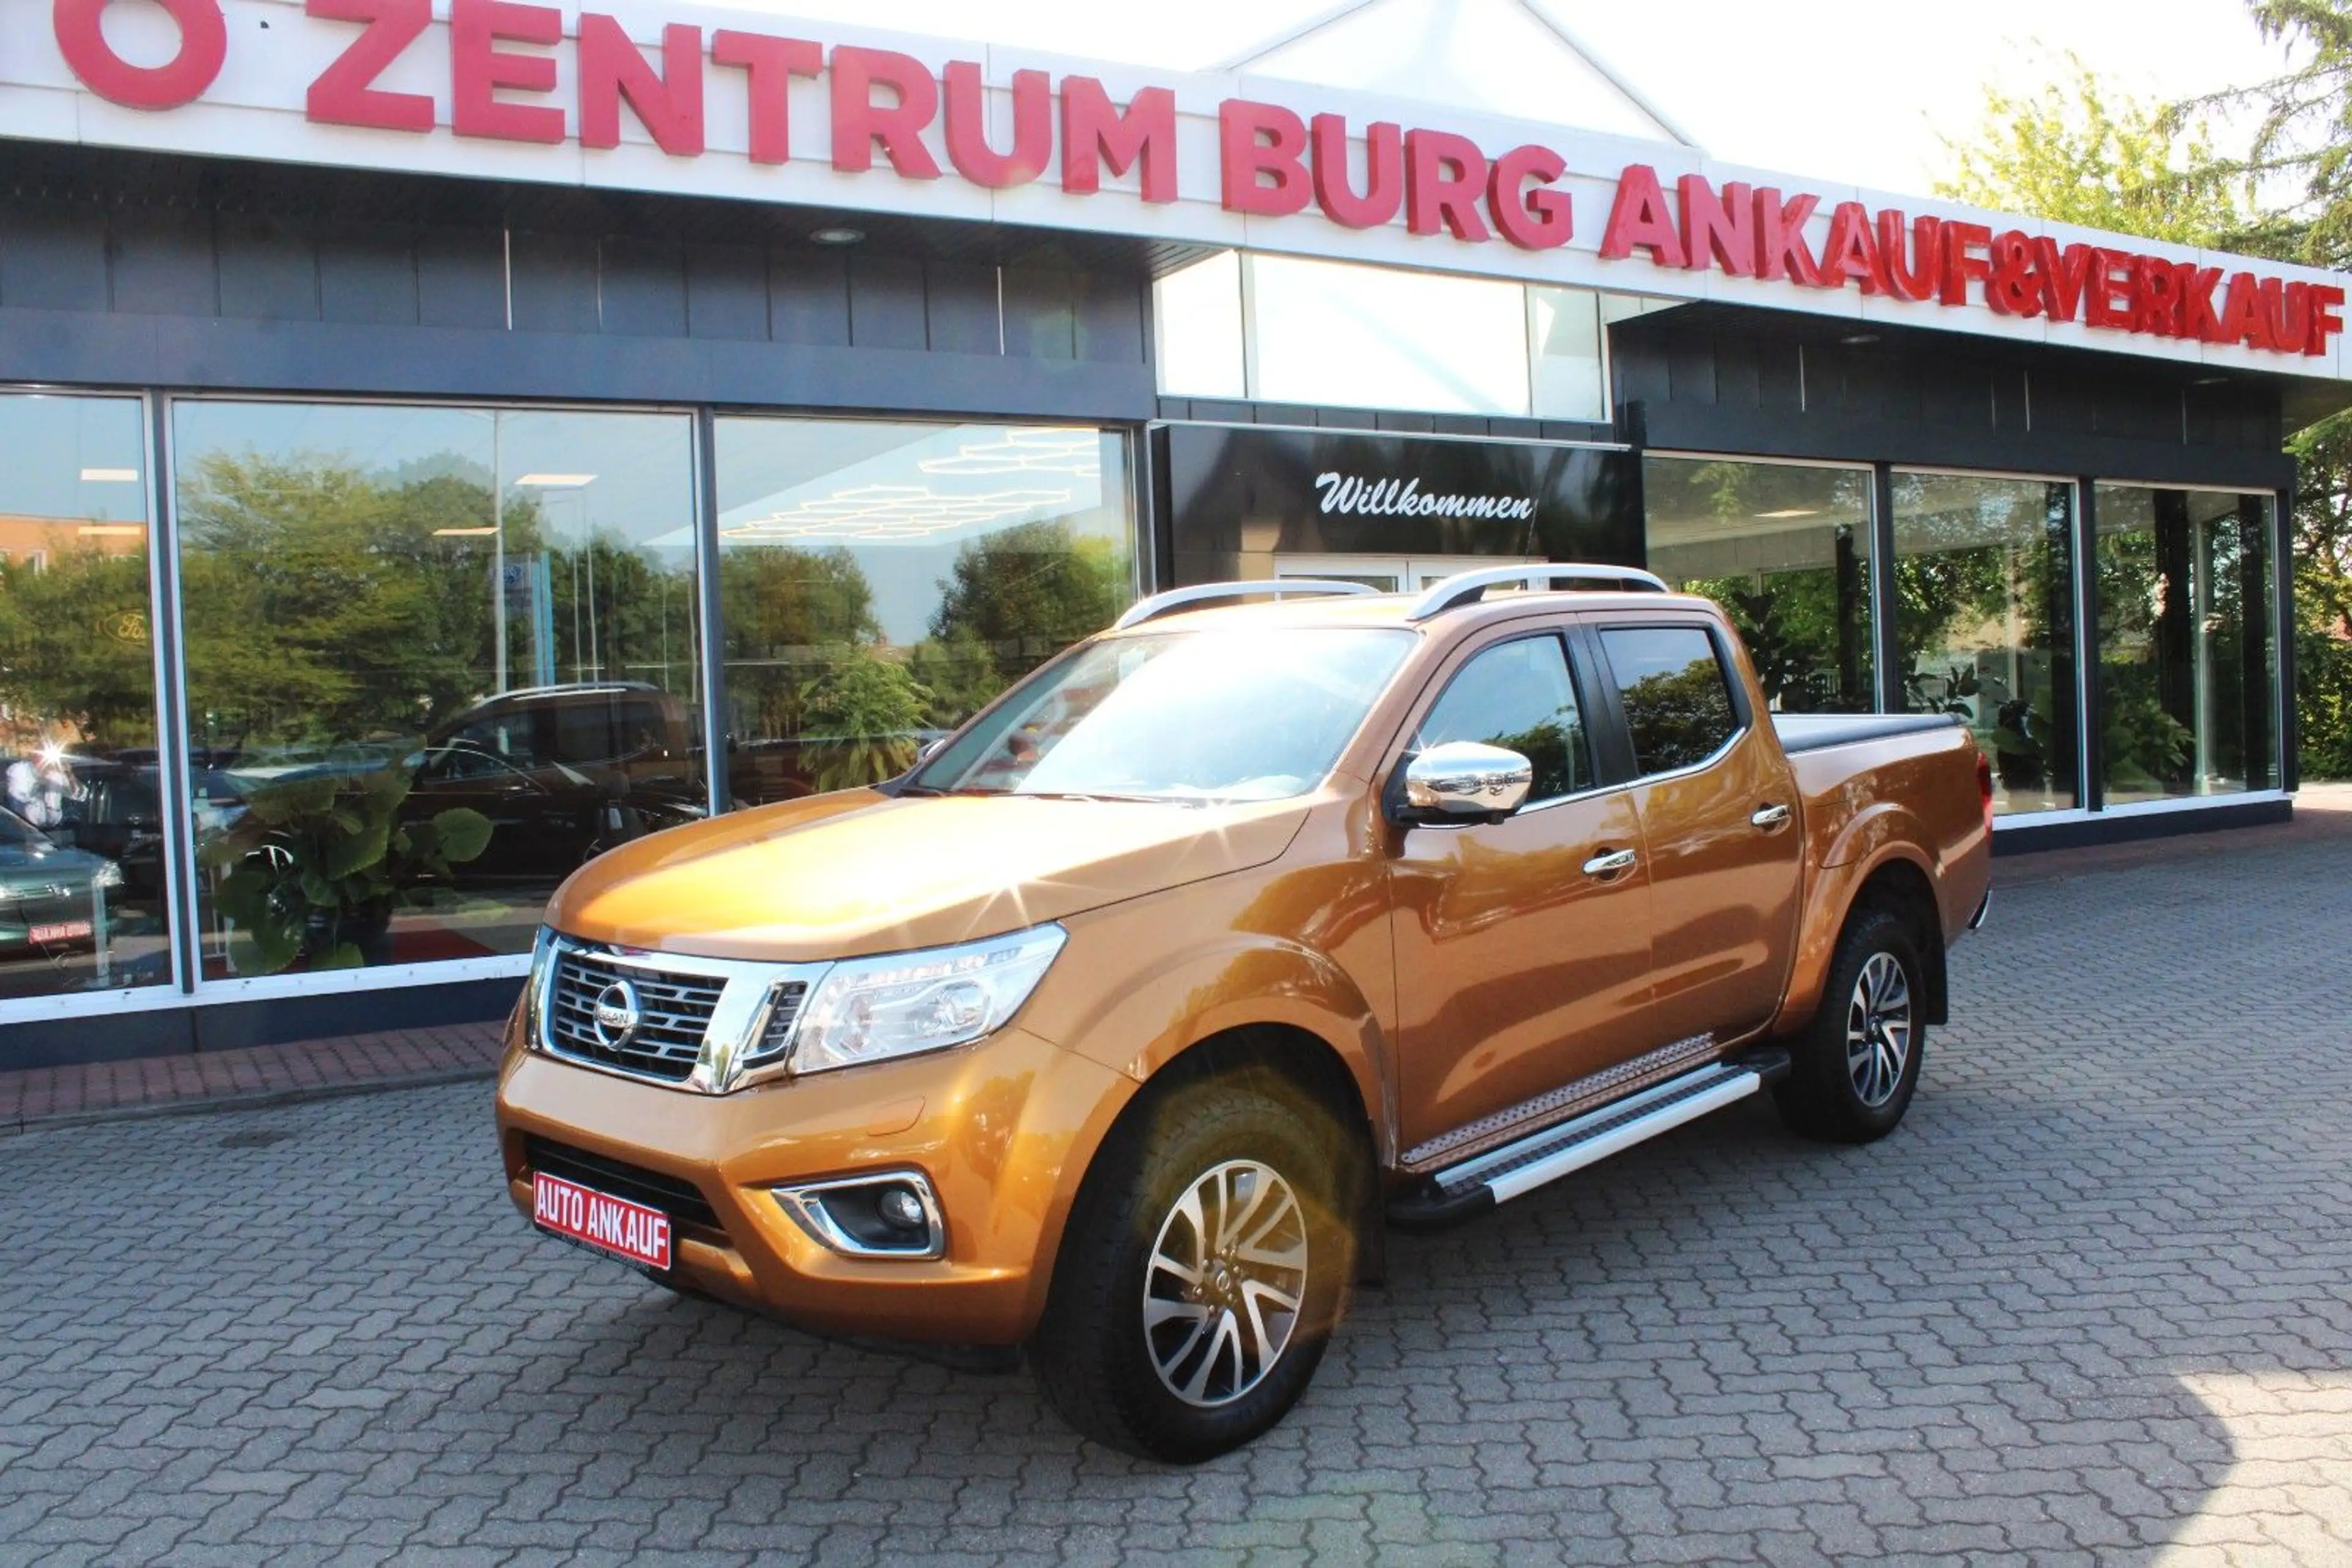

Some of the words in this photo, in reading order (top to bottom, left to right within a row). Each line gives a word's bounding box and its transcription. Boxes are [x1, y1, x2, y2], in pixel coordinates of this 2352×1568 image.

[306, 0, 1177, 204] ZENTRUM
[1219, 98, 1575, 251] BURG
[1315, 472, 1532, 519] Willkommen
[537, 1178, 584, 1232] AUTO
[586, 1197, 668, 1259] ANKAUF
